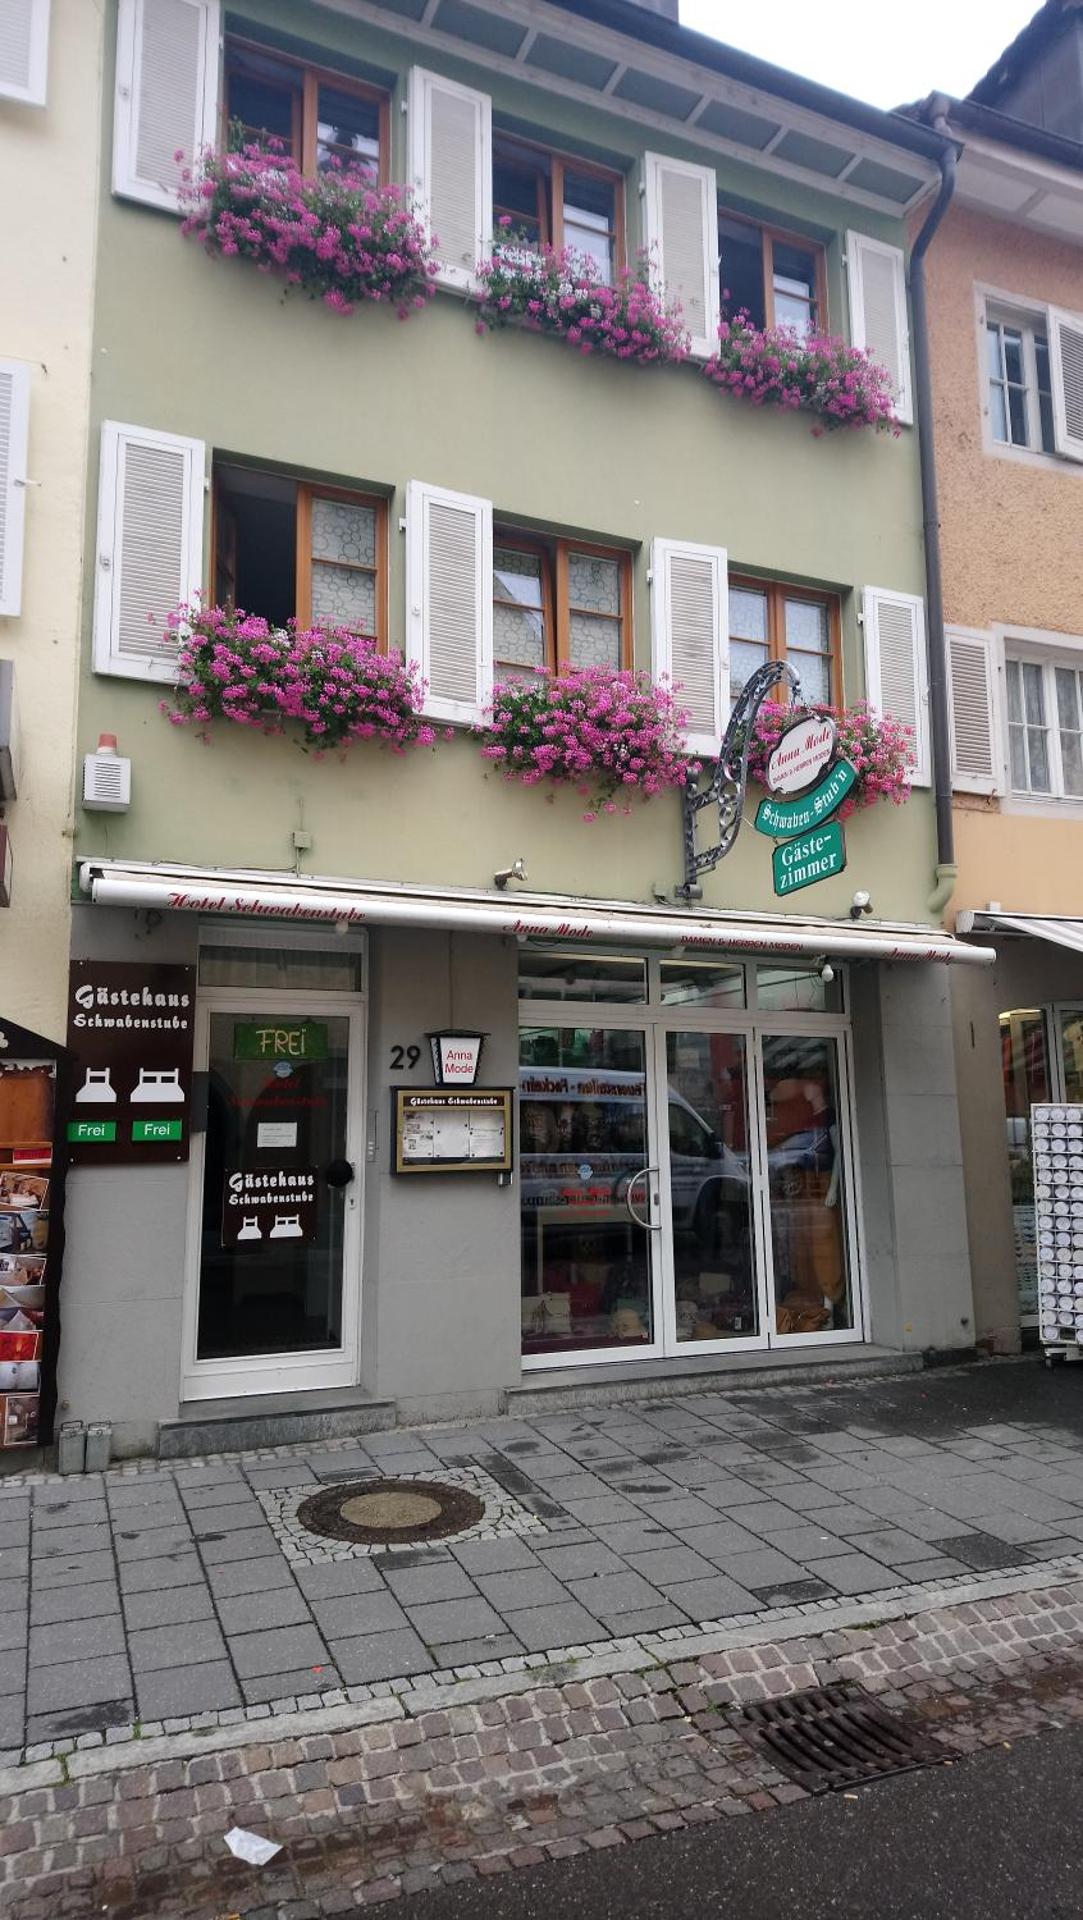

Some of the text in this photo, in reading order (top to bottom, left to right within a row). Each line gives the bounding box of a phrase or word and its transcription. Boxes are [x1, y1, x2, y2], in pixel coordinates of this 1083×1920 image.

[771, 726, 829, 770] Anna Mode
[781, 834, 832, 867] Gäste-
[780, 853, 837, 889] zimmer
[168, 893, 366, 922] Hotel Schwabenstube
[502, 919, 594, 937] Anna Mode
[680, 935, 716, 946] DAMEN
[728, 938, 767, 949] HERREN
[769, 941, 803, 951] MODEN
[75, 984, 190, 1009] Gästehaus
[73, 1013, 188, 1029] Schwabenstube
[390, 1045, 421, 1069] 29
[446, 1050, 472, 1060] Anna
[444, 1063, 473, 1074] Mode
[410, 1096, 498, 1106] Gästehaus Schwabenstube
[78, 1125, 105, 1136] Frei
[144, 1123, 170, 1135] Frei
[228, 1170, 314, 1192] Gästehaus
[228, 1191, 314, 1205] Schwabenstube
